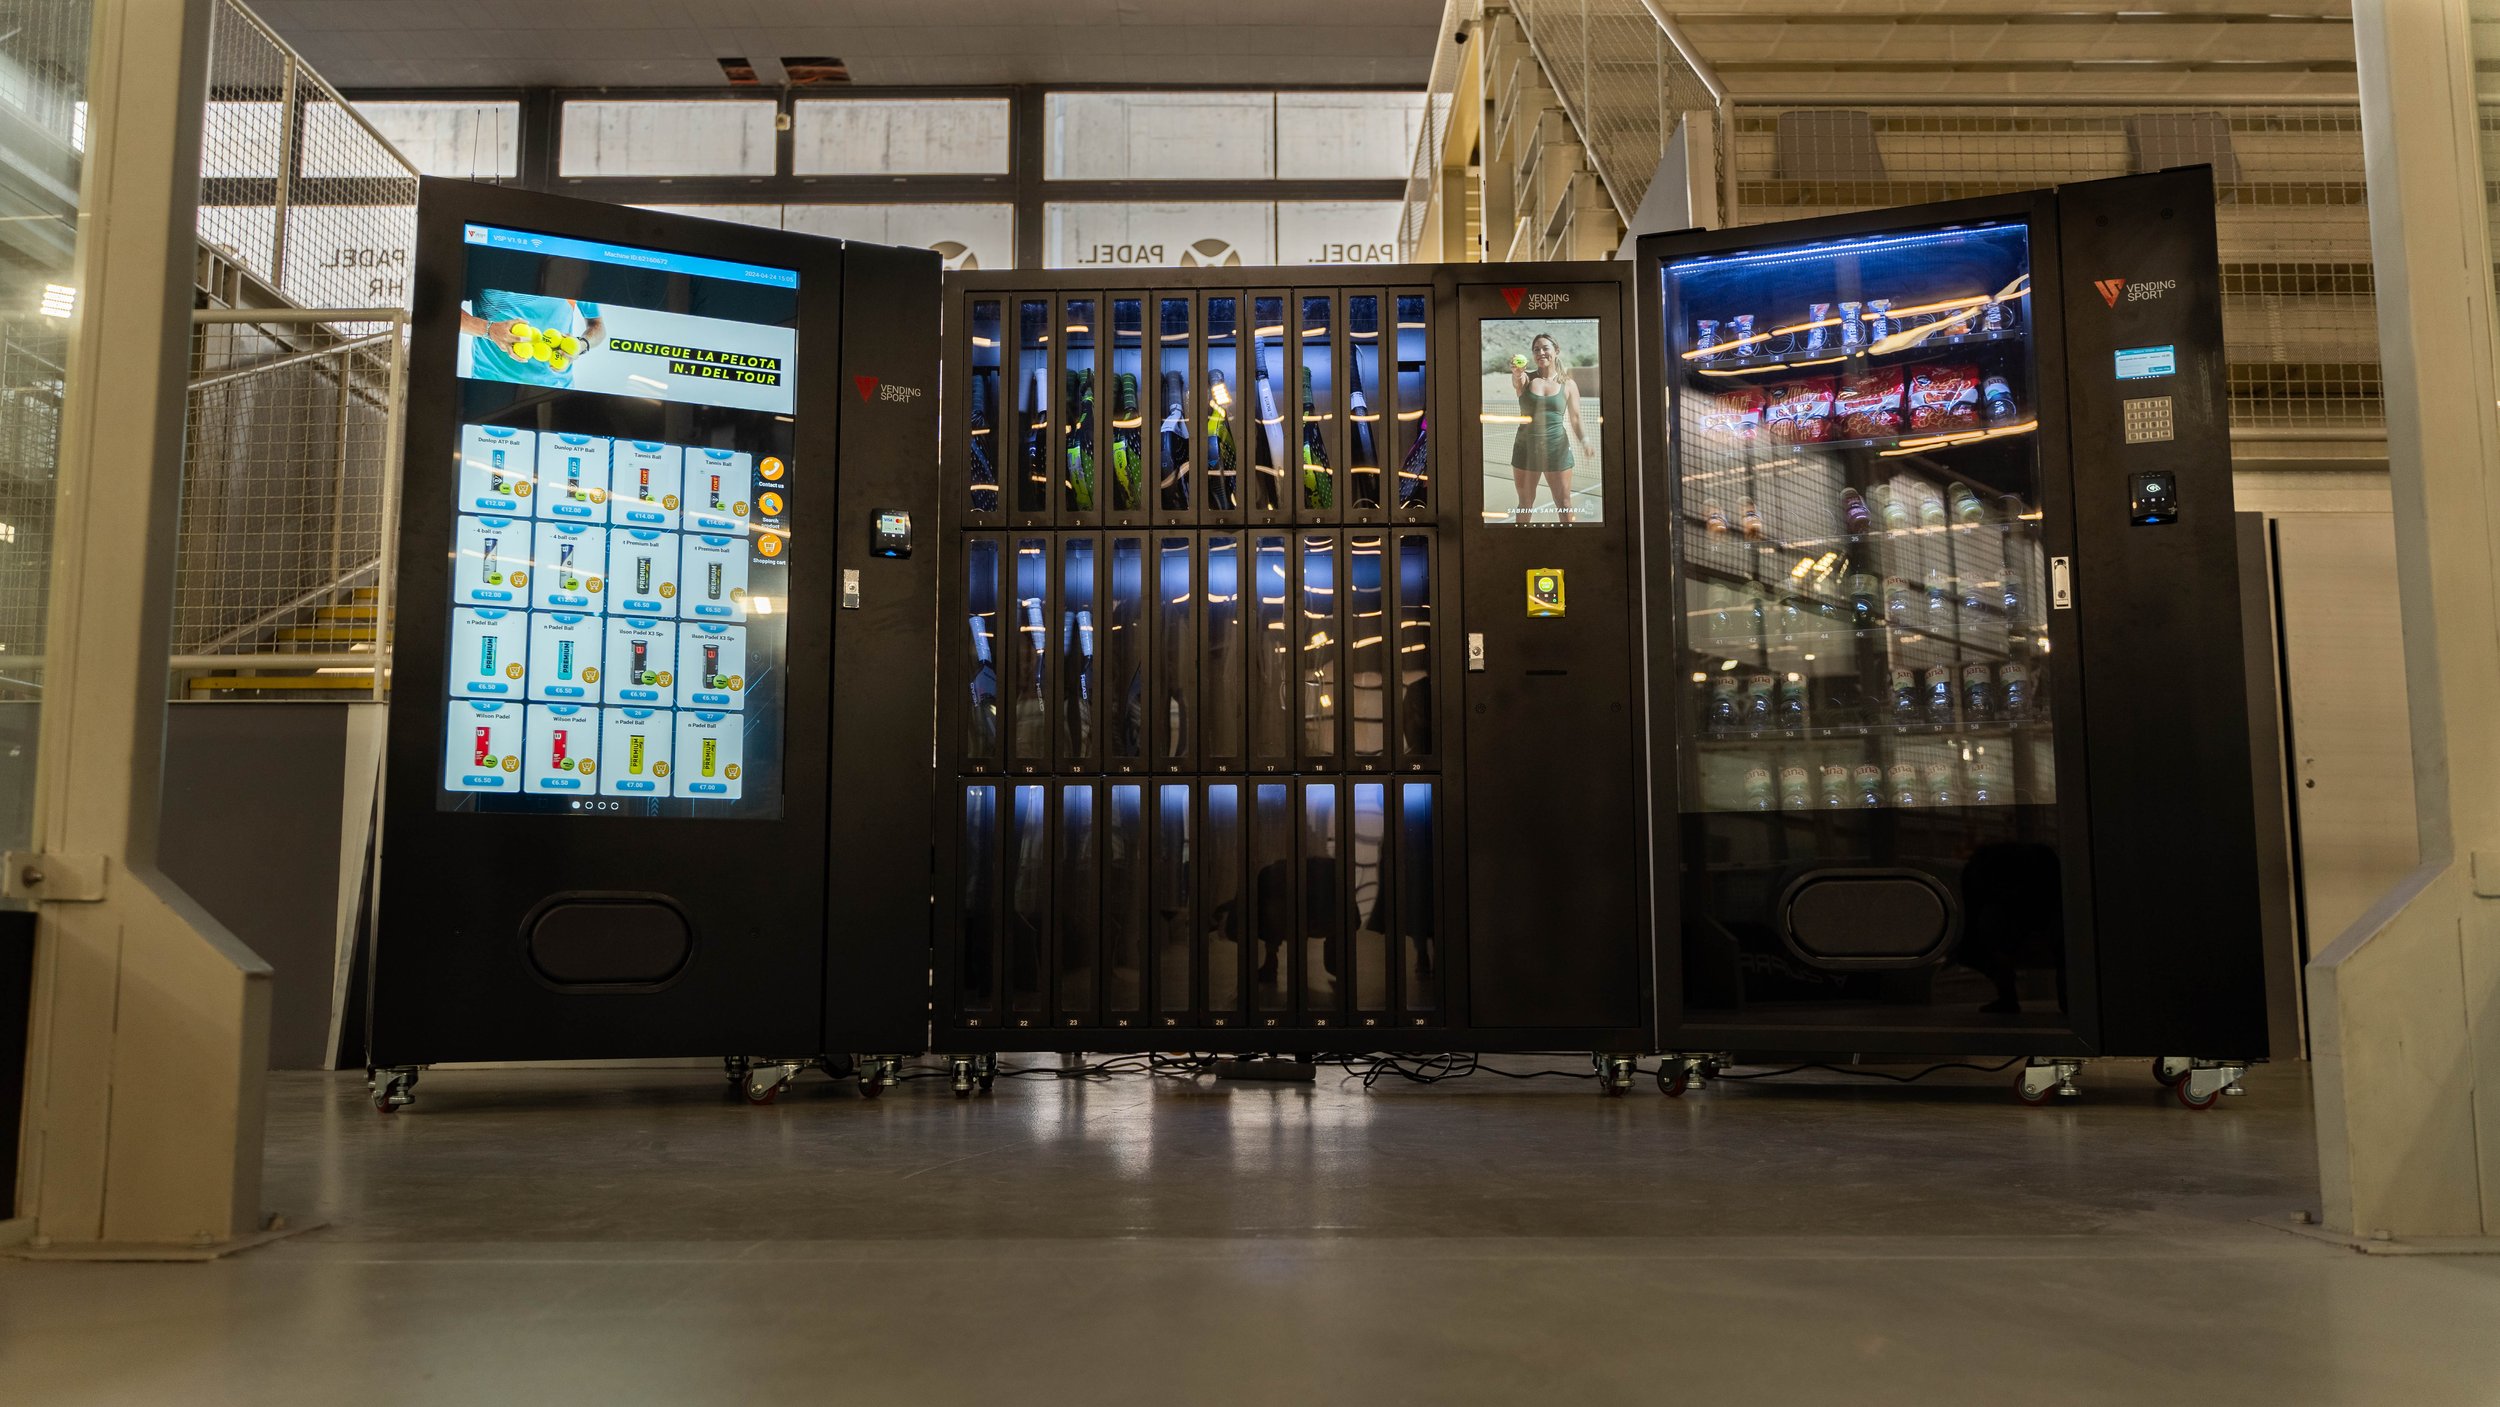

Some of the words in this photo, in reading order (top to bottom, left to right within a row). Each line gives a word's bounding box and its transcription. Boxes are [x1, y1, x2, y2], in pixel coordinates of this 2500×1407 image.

[604, 250, 630, 260] Machine
[745, 270, 777, 280] 2024-04-24
[2126, 279, 2176, 293] VENDING
[1528, 293, 1569, 302] VENDING
[2127, 290, 2164, 302] SPORT
[1528, 301, 1559, 310] SPORT
[610, 340, 691, 360] CONSIGUE
[696, 350, 714, 362] LA
[720, 353, 776, 370] PELOTA
[674, 363, 696, 375] N.1
[702, 366, 730, 380] DEL
[736, 370, 776, 385] TOUR
[880, 384, 921, 397] VENDING
[880, 392, 911, 404] SPORT
[1036, 683, 1044, 711] HEAD
